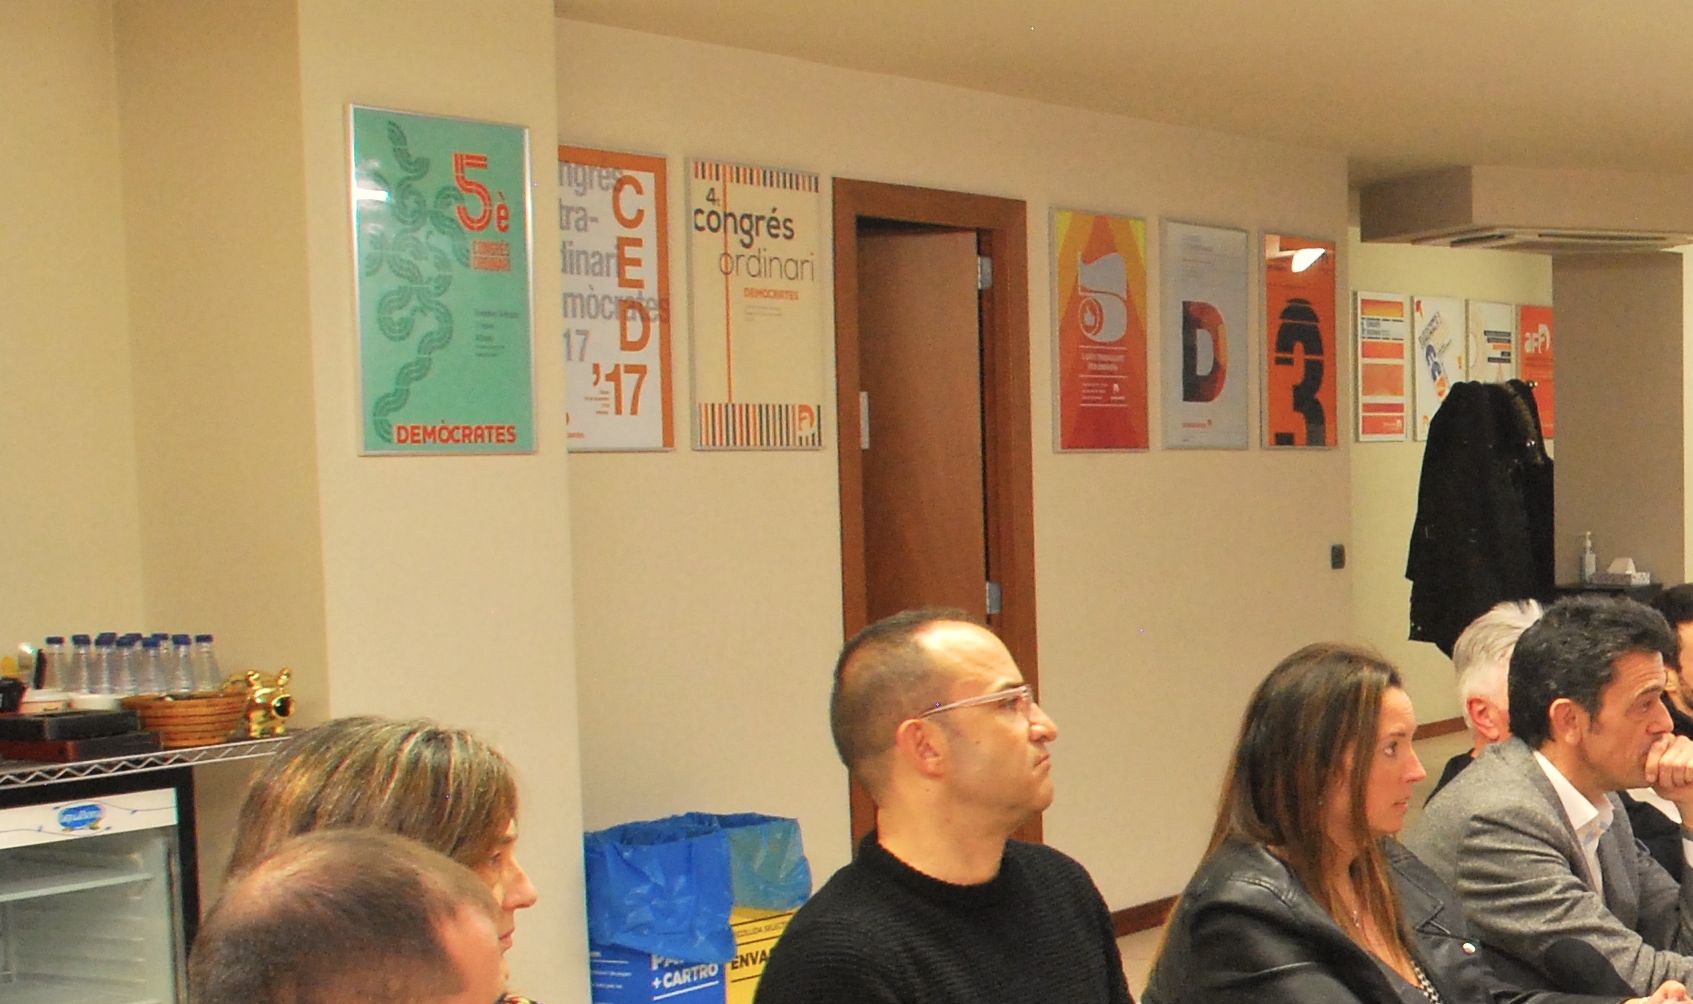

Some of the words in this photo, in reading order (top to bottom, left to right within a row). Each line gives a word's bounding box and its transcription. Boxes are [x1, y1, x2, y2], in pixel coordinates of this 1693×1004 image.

[693, 206, 796, 249] congrés
[719, 248, 815, 281] ordinari
[395, 419, 517, 445] DEMÒCRATES
